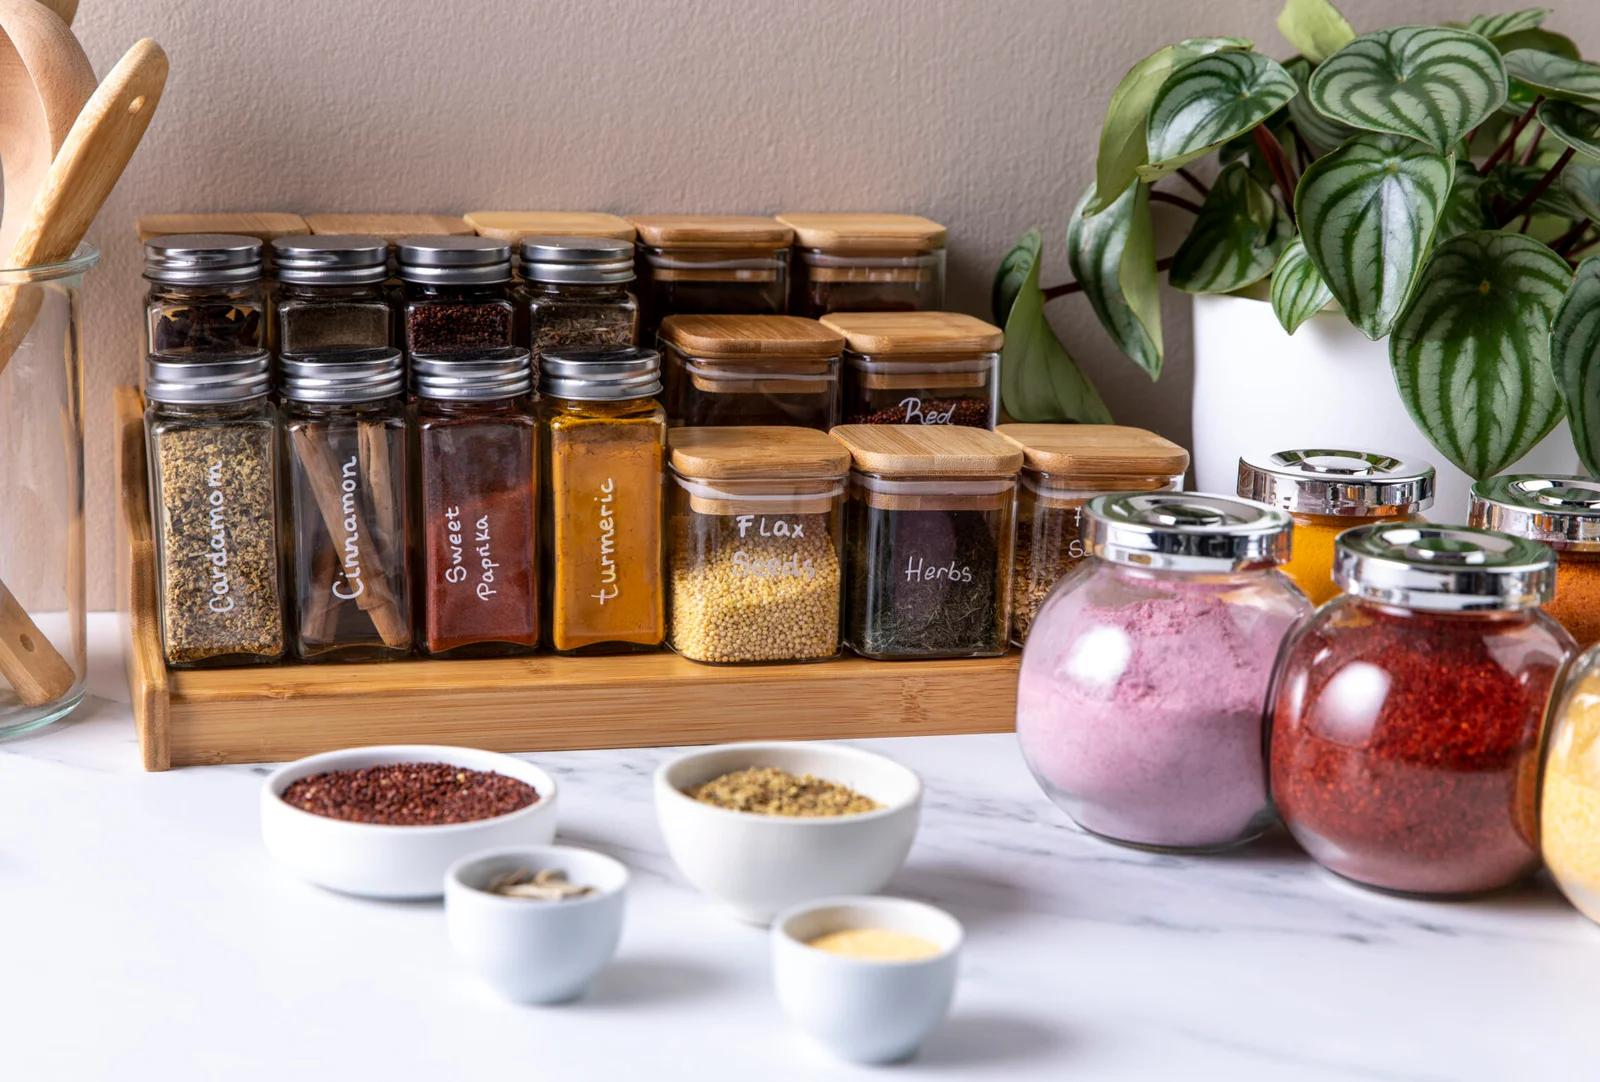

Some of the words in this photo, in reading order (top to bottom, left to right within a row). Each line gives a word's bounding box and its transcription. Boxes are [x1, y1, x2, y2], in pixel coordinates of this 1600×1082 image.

[898, 397, 957, 425] Red
[205, 460, 234, 613] Cardamom
[332, 455, 365, 600] Cinnamon
[445, 505, 467, 584] Sweet
[733, 550, 816, 580] Seeds
[904, 556, 972, 582] Herbs
